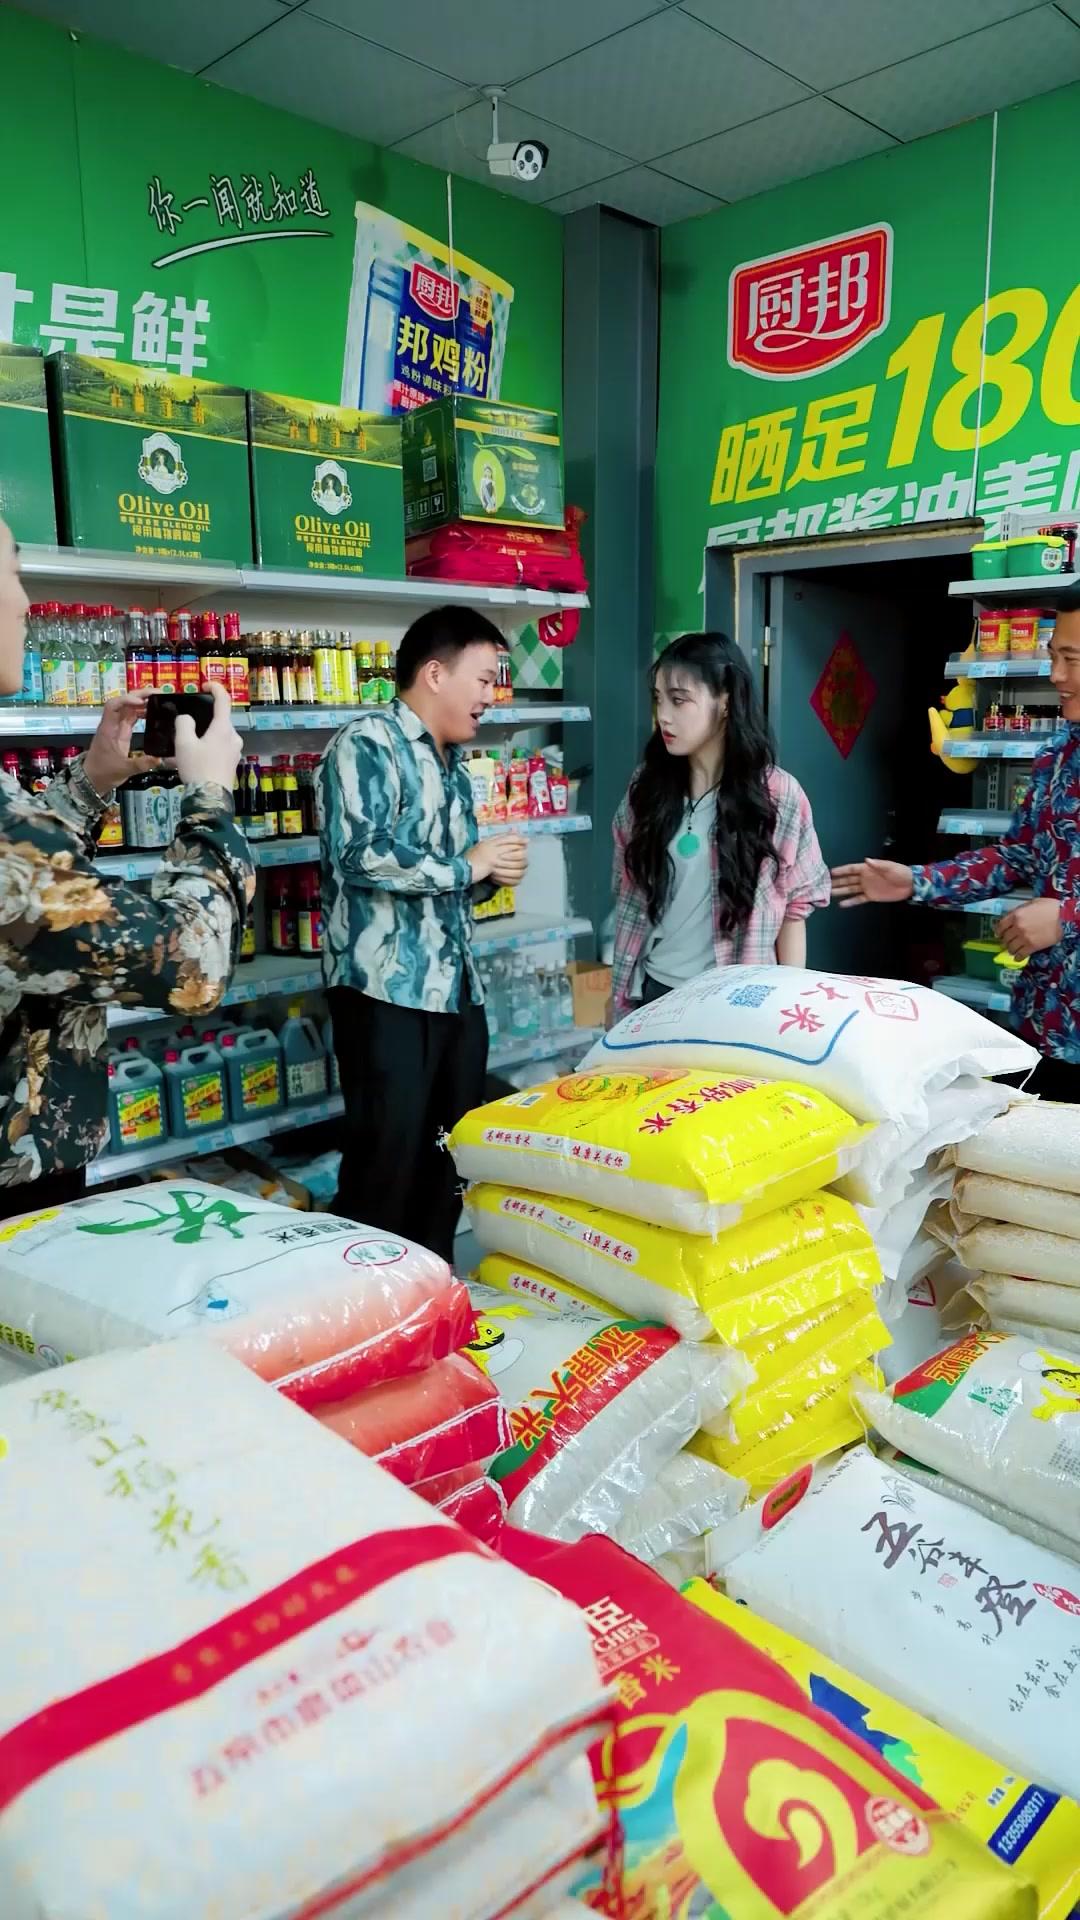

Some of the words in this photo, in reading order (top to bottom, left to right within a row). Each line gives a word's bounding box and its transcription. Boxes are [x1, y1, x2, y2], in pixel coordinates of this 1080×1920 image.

[149, 169, 330, 235] 你一闻就知道
[746, 249, 871, 353] 厨邦
[396, 314, 487, 392] 邦鸡粉
[118, 493, 174, 517] Olive
[180, 501, 210, 521] Oil
[295, 515, 340, 536] Olive
[345, 521, 371, 538] Oil
[861, 1511, 1037, 1638] 五谷丰登
[997, 1791, 1046, 1855] 13355889317
